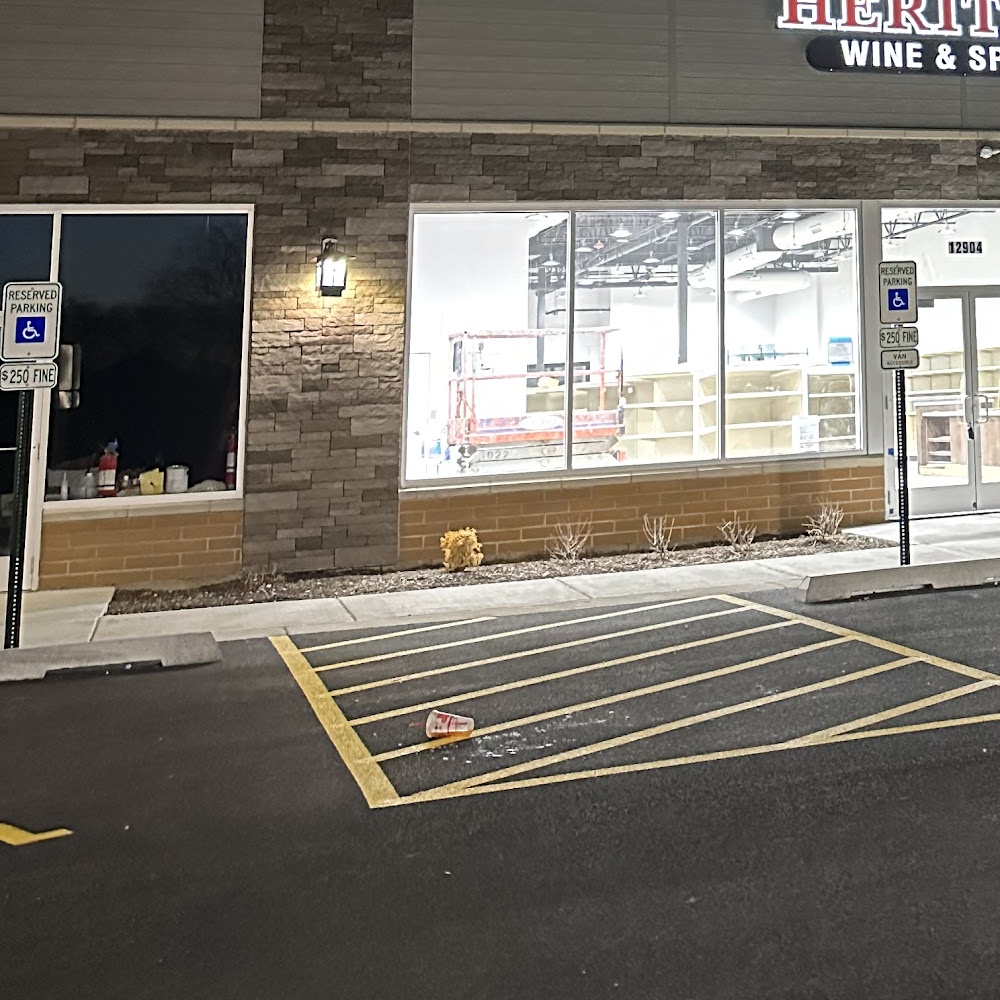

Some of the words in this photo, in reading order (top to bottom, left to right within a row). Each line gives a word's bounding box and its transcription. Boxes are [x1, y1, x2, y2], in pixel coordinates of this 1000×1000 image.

[840, 39, 923, 69] WINE
[935, 43, 957, 71] &
[948, 241, 982, 253] 12904
[881, 266, 914, 275] RESERVED
[883, 278, 913, 286] PARKING
[8, 290, 57, 301] RESERVED
[10, 303, 53, 313] PARKING
[902, 330, 918, 343] FINE
[33, 368, 55, 383] FINE
